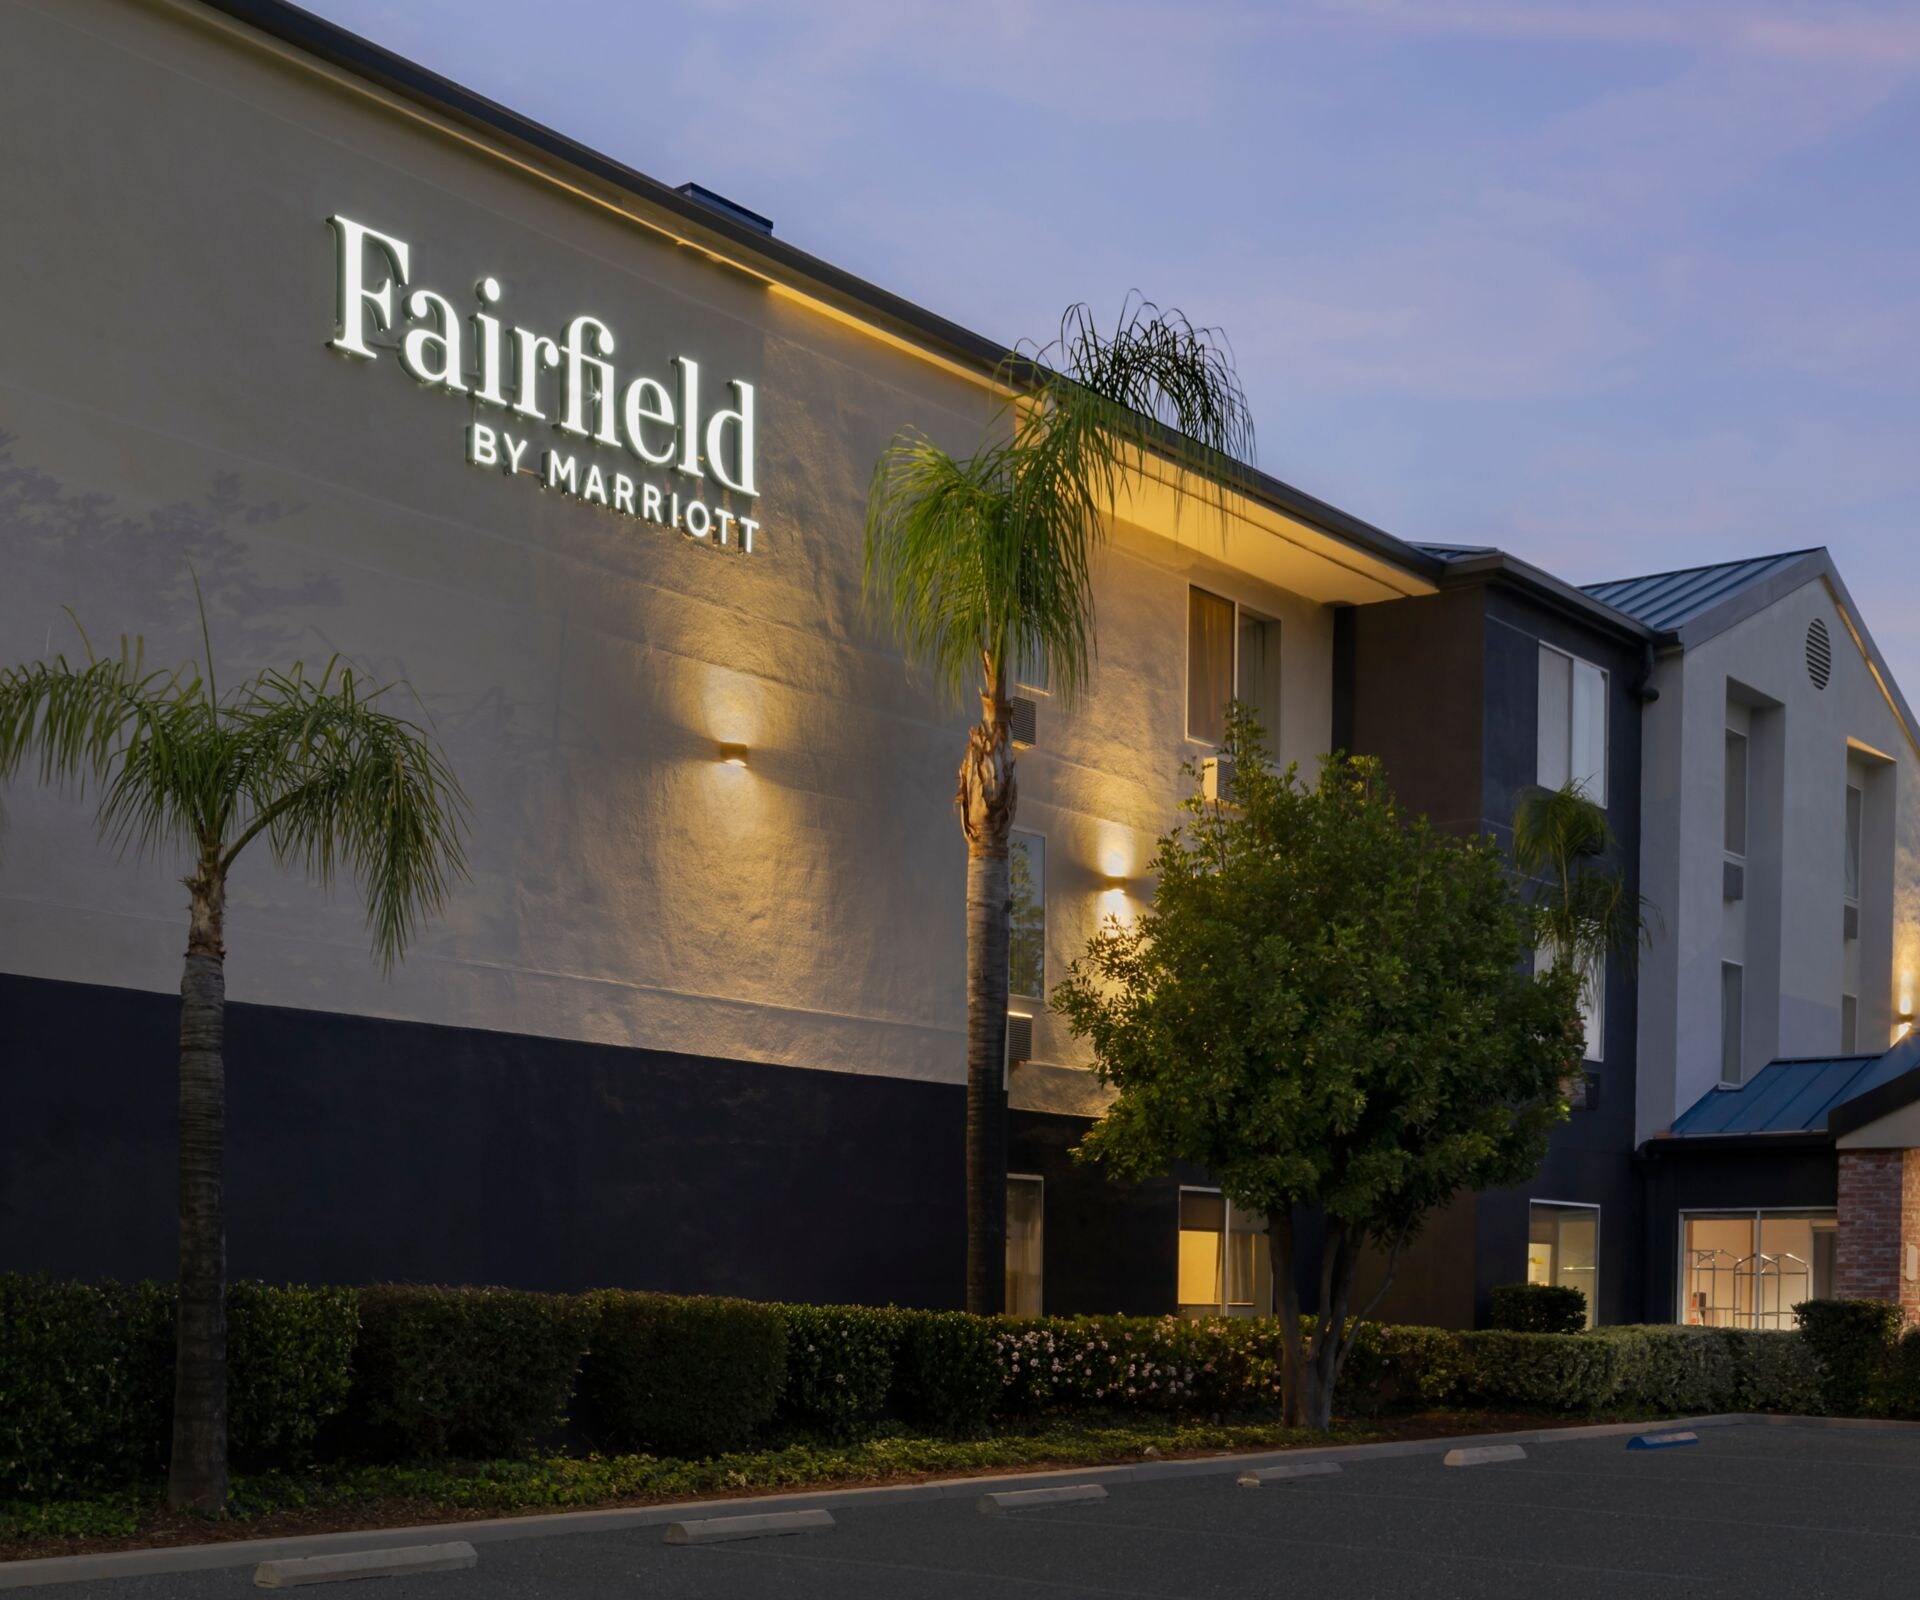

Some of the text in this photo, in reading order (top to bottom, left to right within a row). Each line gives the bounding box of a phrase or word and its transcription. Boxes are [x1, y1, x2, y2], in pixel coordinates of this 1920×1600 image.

[332, 214, 761, 498] Fairfield
[473, 422, 761, 554] BY MARRIOTT
